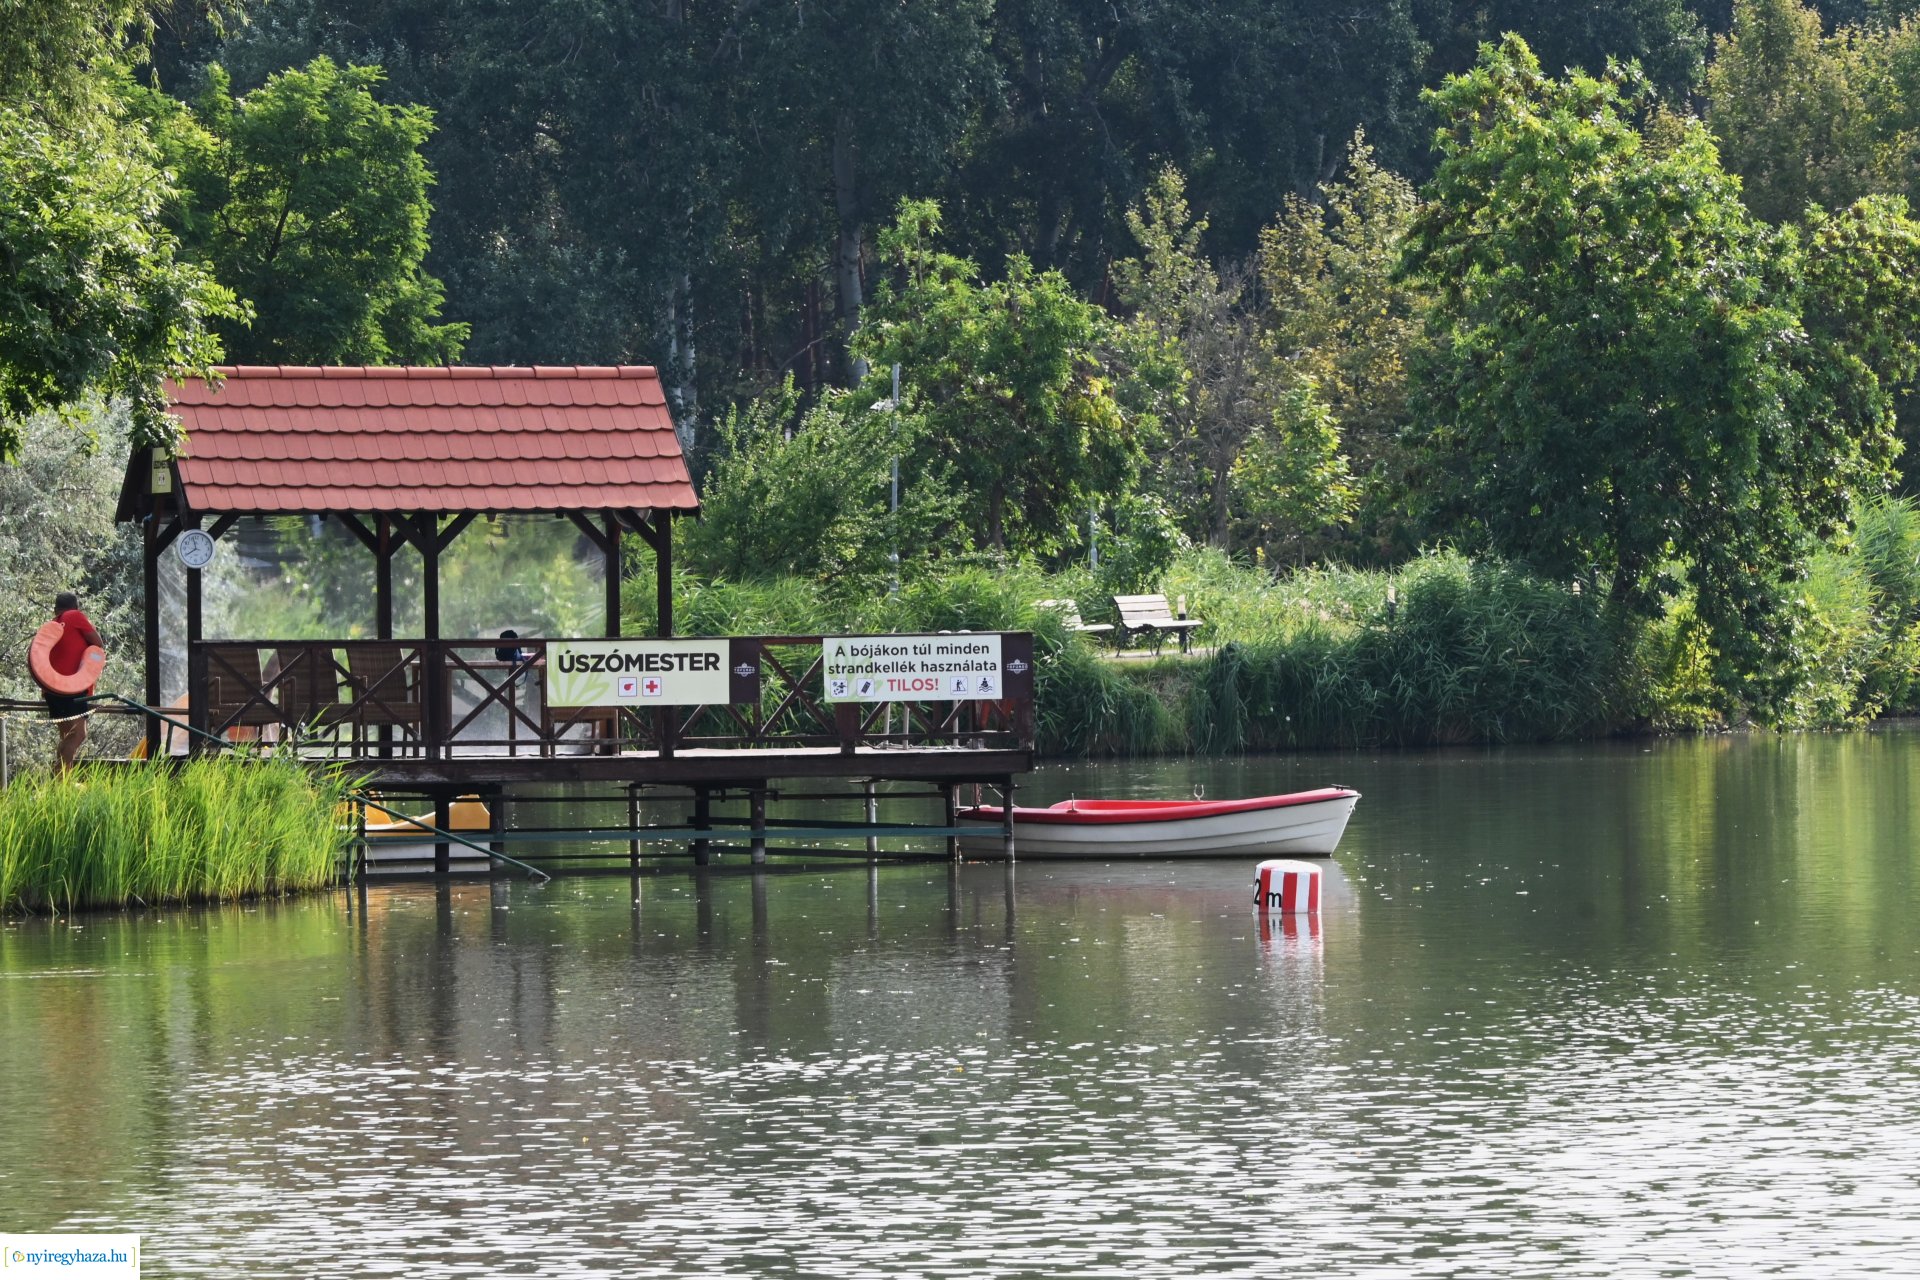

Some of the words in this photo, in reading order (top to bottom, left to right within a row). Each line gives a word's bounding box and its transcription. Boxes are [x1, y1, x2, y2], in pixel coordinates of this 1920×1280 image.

[835, 646, 846, 657] A
[851, 643, 908, 659] bójákon
[912, 642, 931, 656] túl
[936, 643, 990, 655] minden
[558, 648, 720, 673] ÚSZÓMESTER
[828, 661, 916, 675] strandkellék
[921, 660, 997, 673] használata
[887, 678, 939, 692] TILOS!
